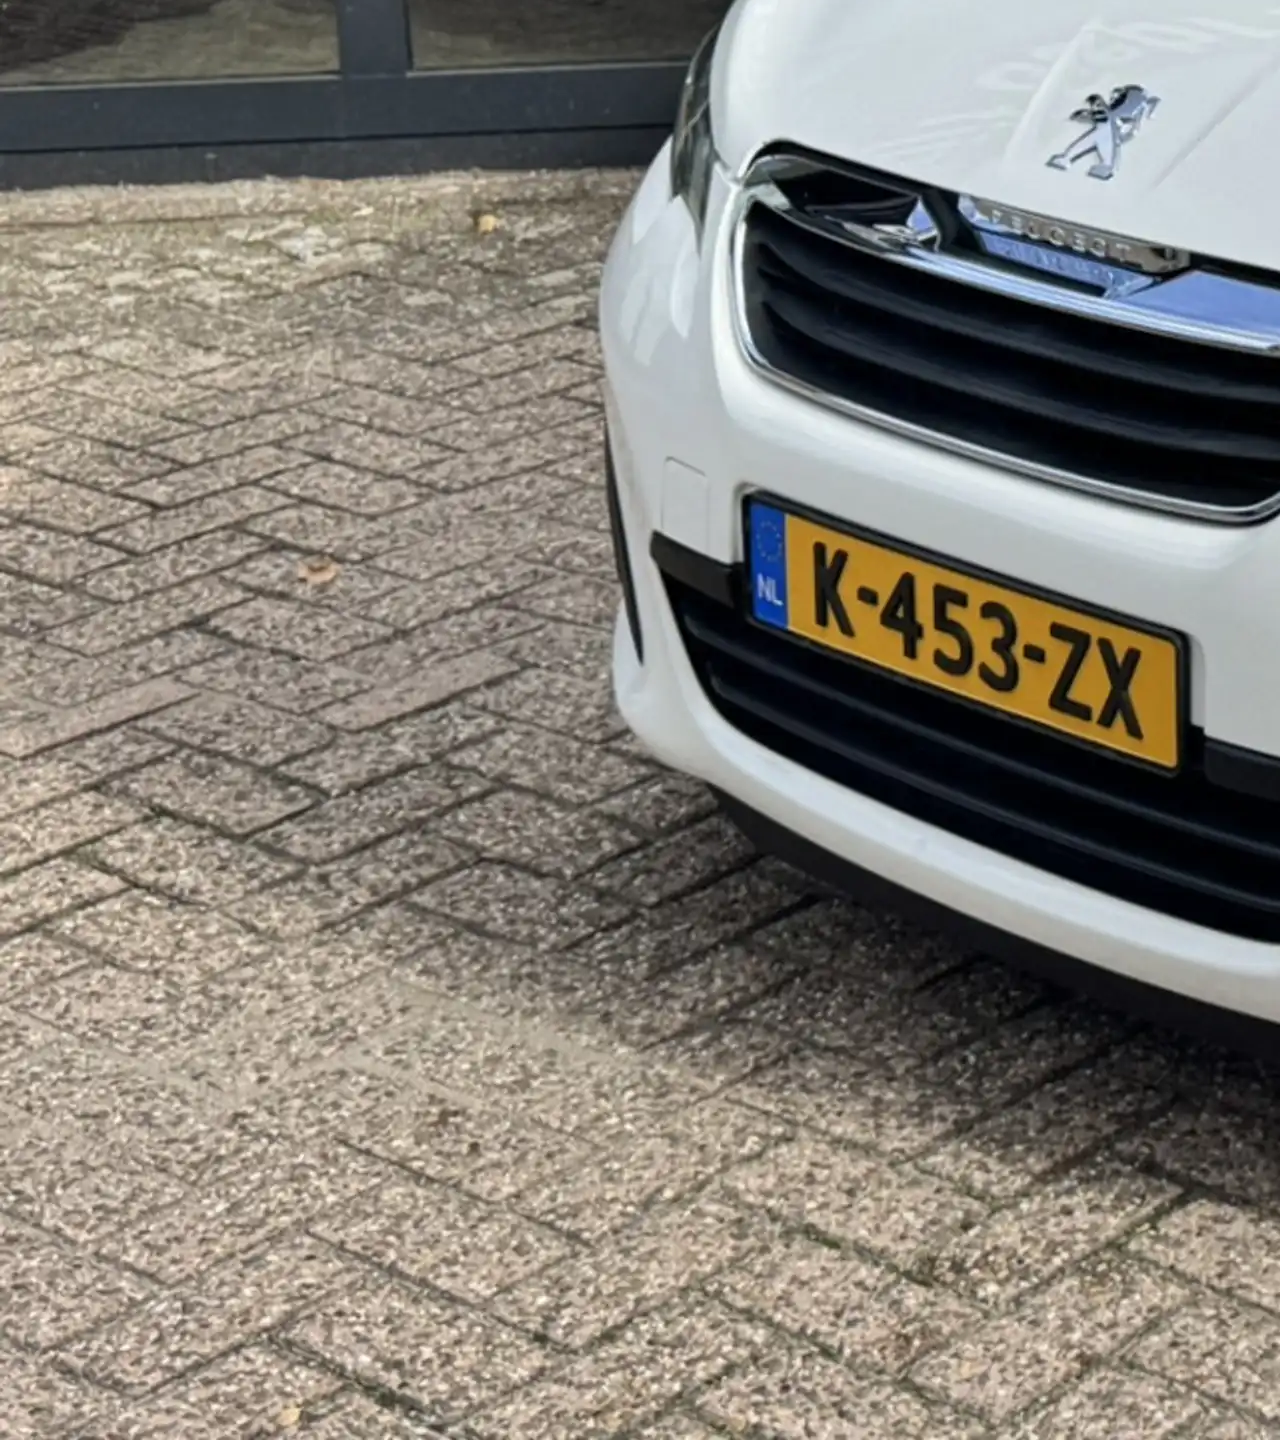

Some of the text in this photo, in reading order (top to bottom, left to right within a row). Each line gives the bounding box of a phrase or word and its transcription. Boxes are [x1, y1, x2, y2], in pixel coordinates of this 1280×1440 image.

[990, 209, 1132, 262] PEUGEOT
[757, 572, 784, 606] NL
[812, 541, 1144, 741] K-453-ZX
